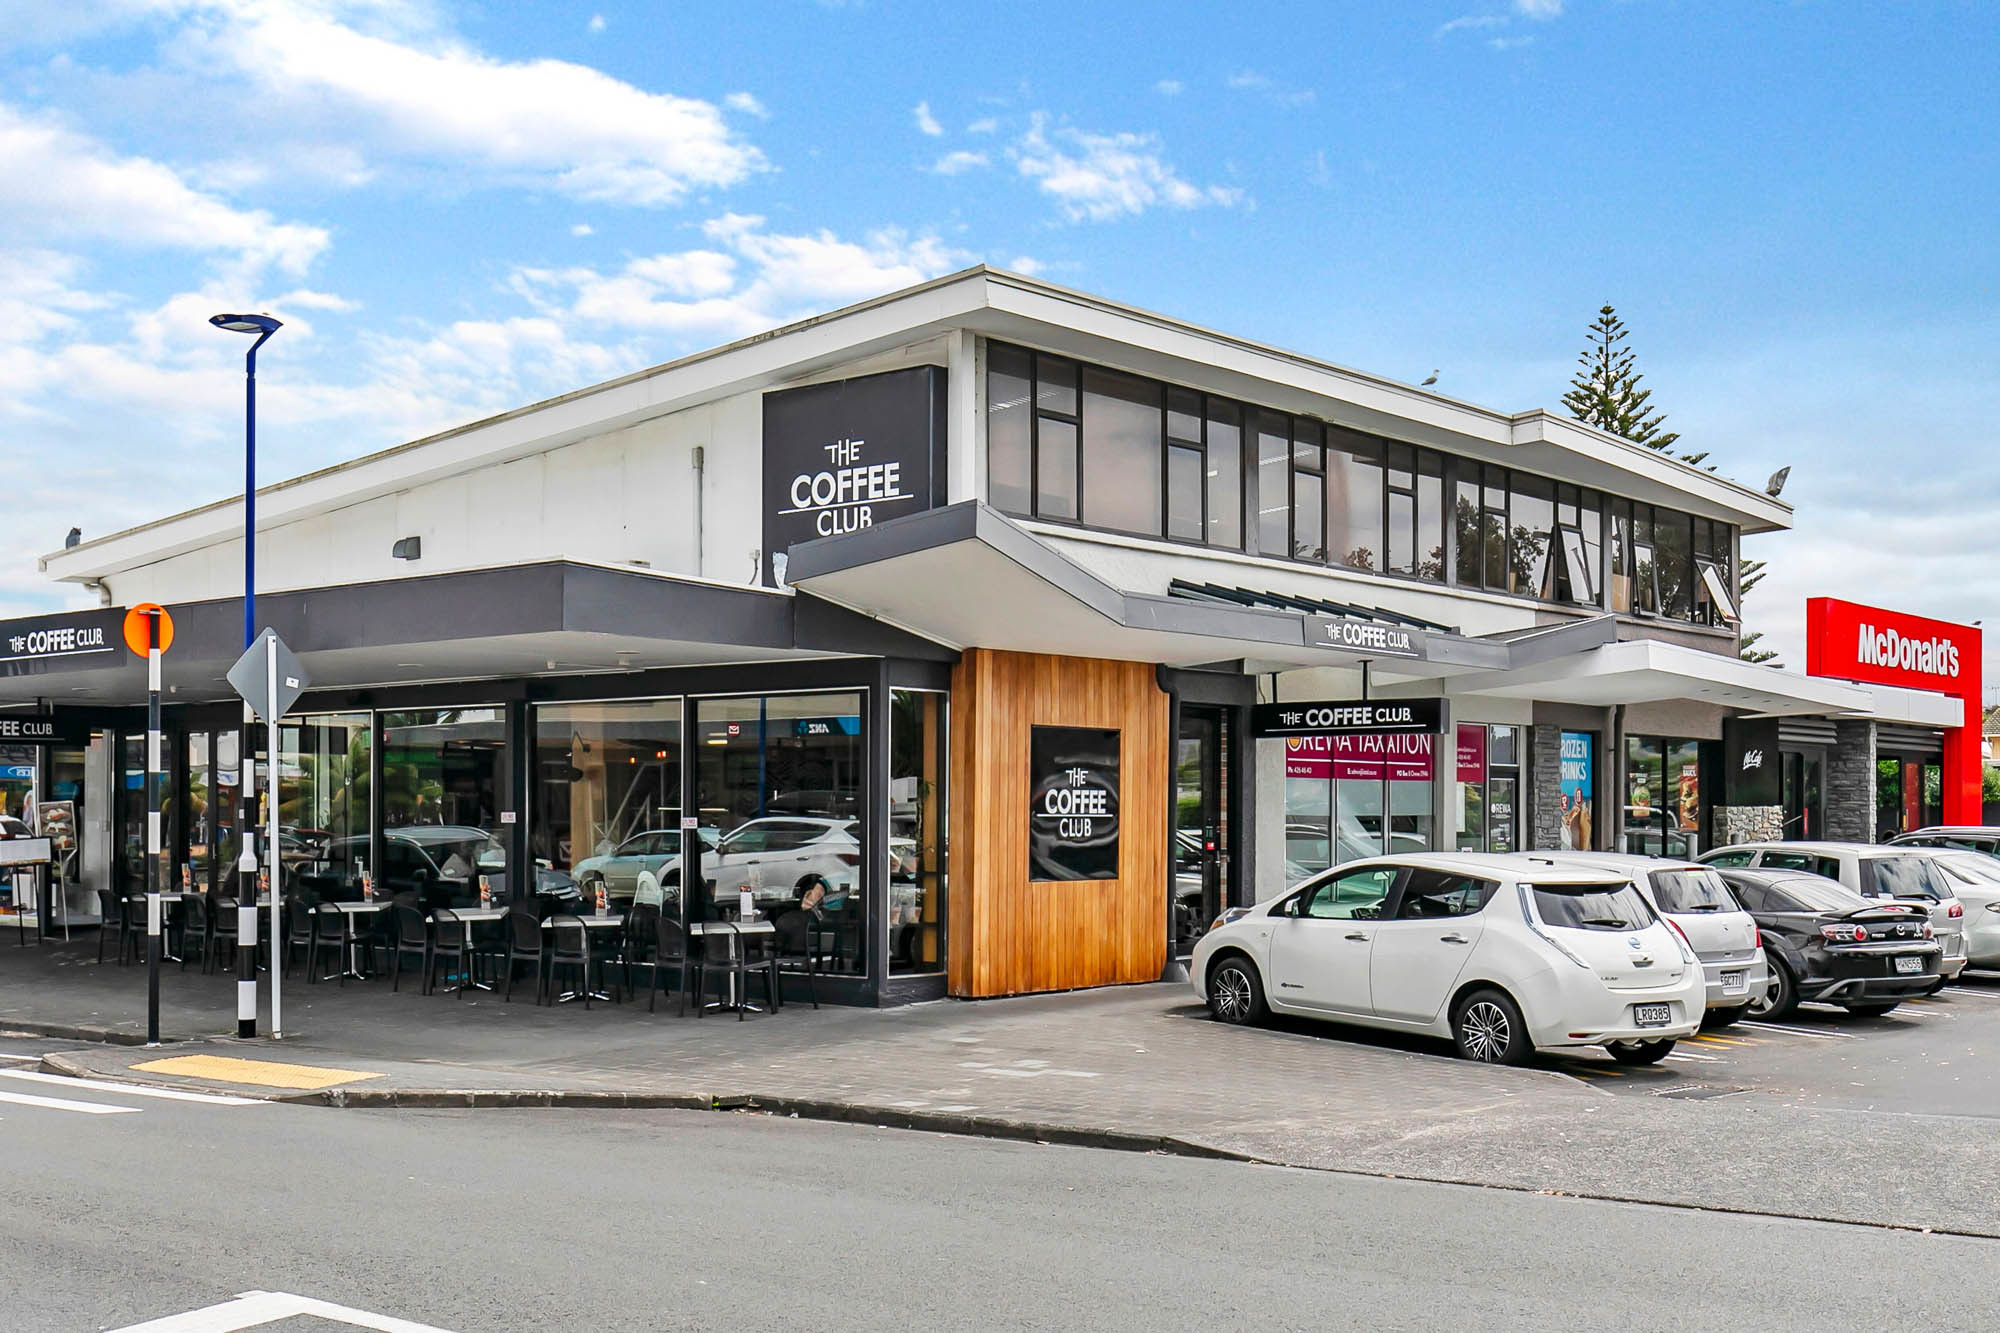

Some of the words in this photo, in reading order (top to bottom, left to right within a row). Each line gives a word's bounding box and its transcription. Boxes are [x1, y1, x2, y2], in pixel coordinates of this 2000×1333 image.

[824, 439, 864, 466] THE
[791, 462, 900, 508] COFFEE
[817, 506, 873, 536] CLUB
[9, 635, 26, 652] THE
[27, 628, 75, 653] COFFEE
[1325, 623, 1341, 640] THE
[1343, 623, 1386, 648] COFFEE
[1858, 623, 1960, 677] McDonald's
[1279, 712, 1303, 725] THE
[1305, 707, 1372, 726] COFFEE
[1560, 739, 1587, 759] ROZEN
[1065, 768, 1089, 787] THE
[1560, 761, 1587, 780] RINKS
[1045, 789, 1107, 814] COFFEE
[1060, 818, 1092, 837] CLUB
